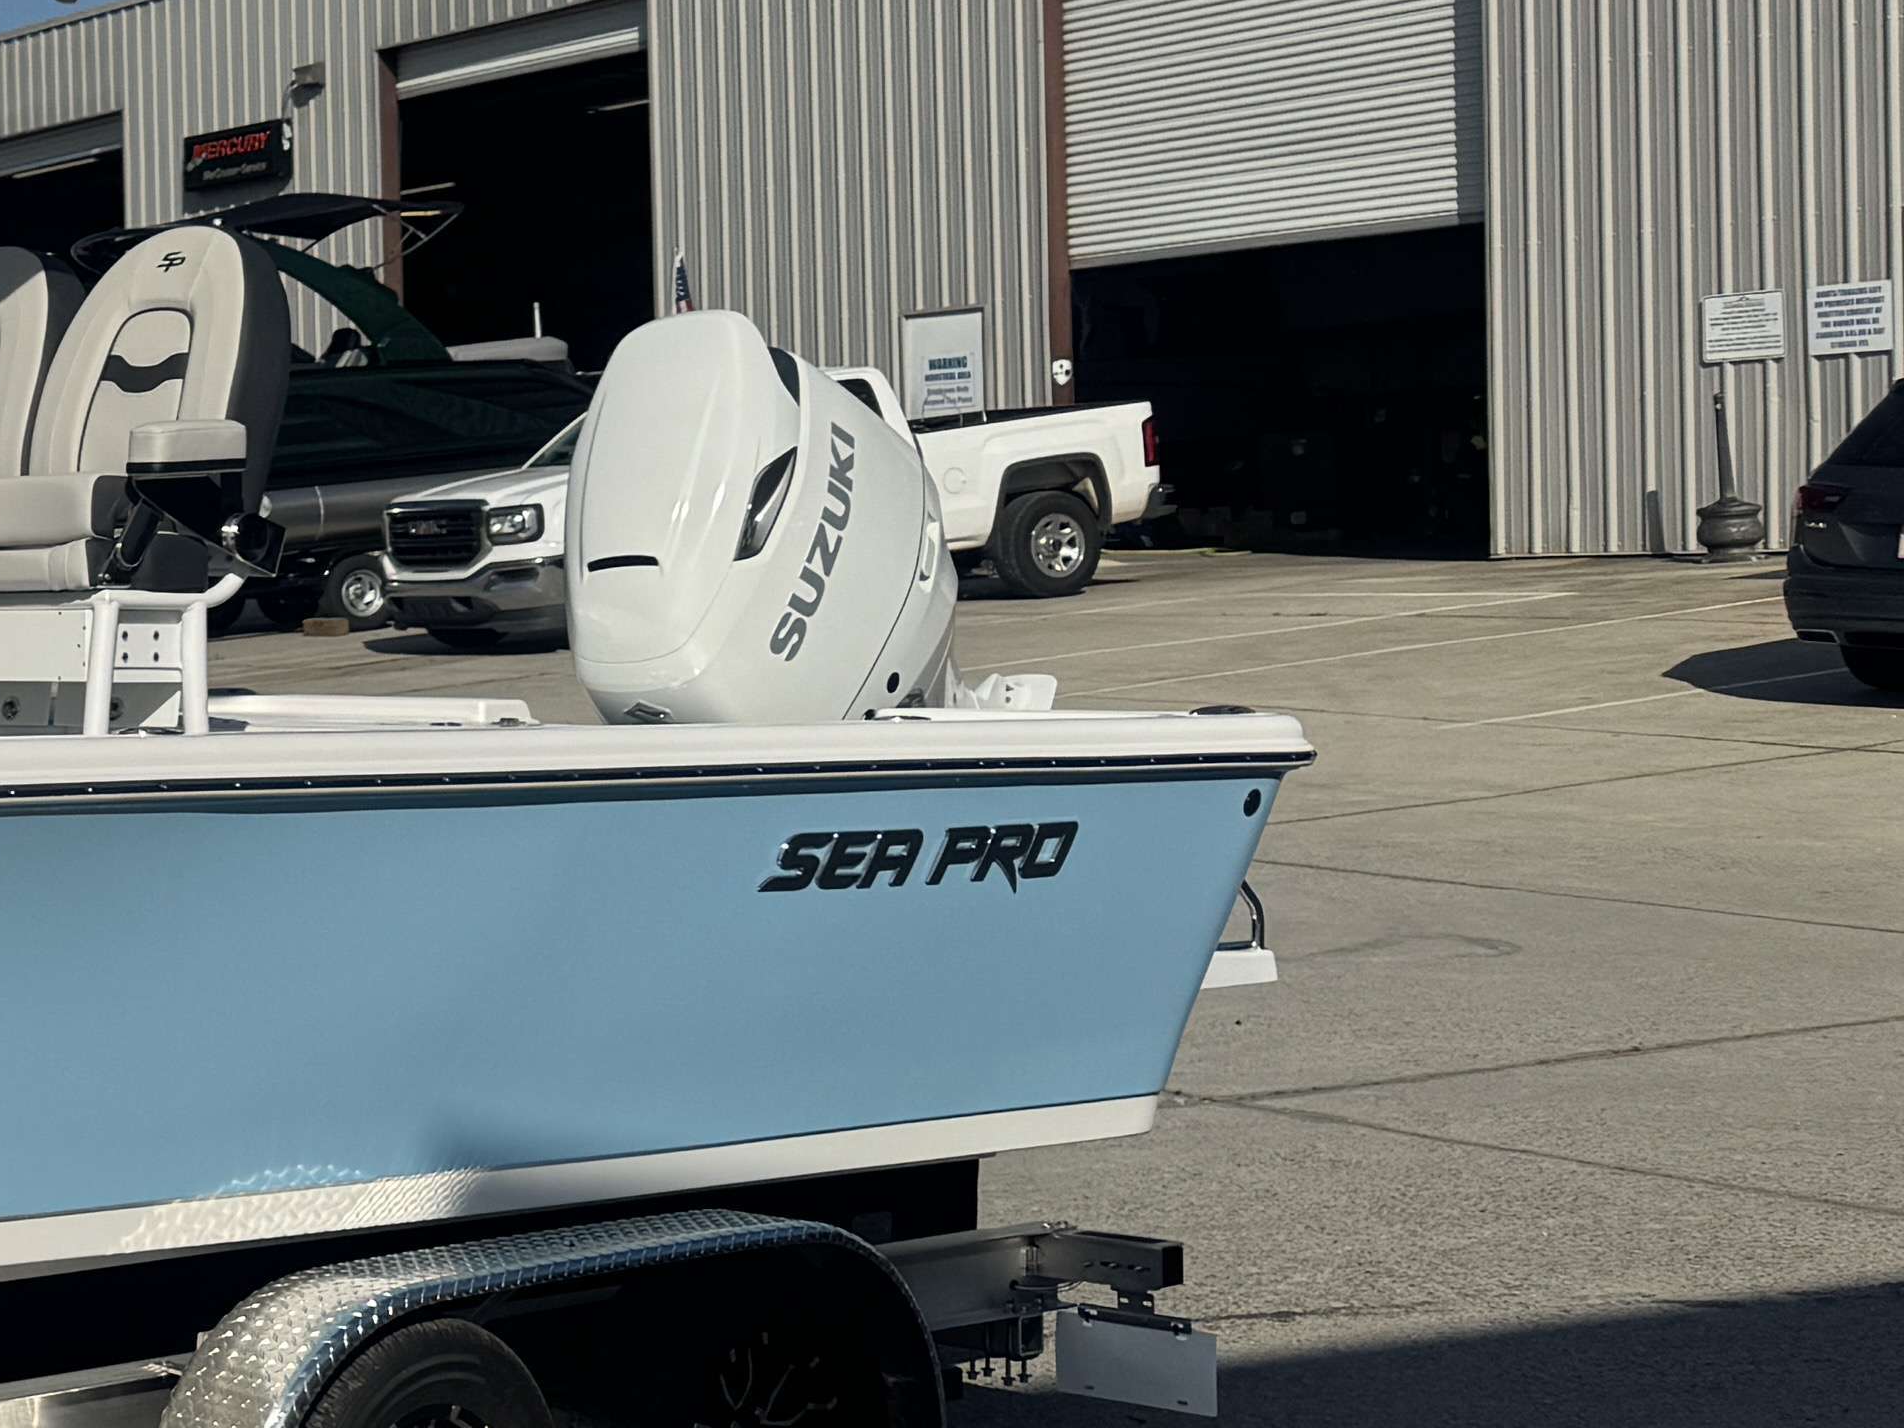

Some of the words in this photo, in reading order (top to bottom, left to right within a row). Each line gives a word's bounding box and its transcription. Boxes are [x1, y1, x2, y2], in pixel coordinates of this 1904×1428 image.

[193, 132, 270, 161] MERCURY
[770, 421, 856, 662] SUZUKI
[757, 828, 924, 893] SEA
[925, 820, 1080, 894] PRO
